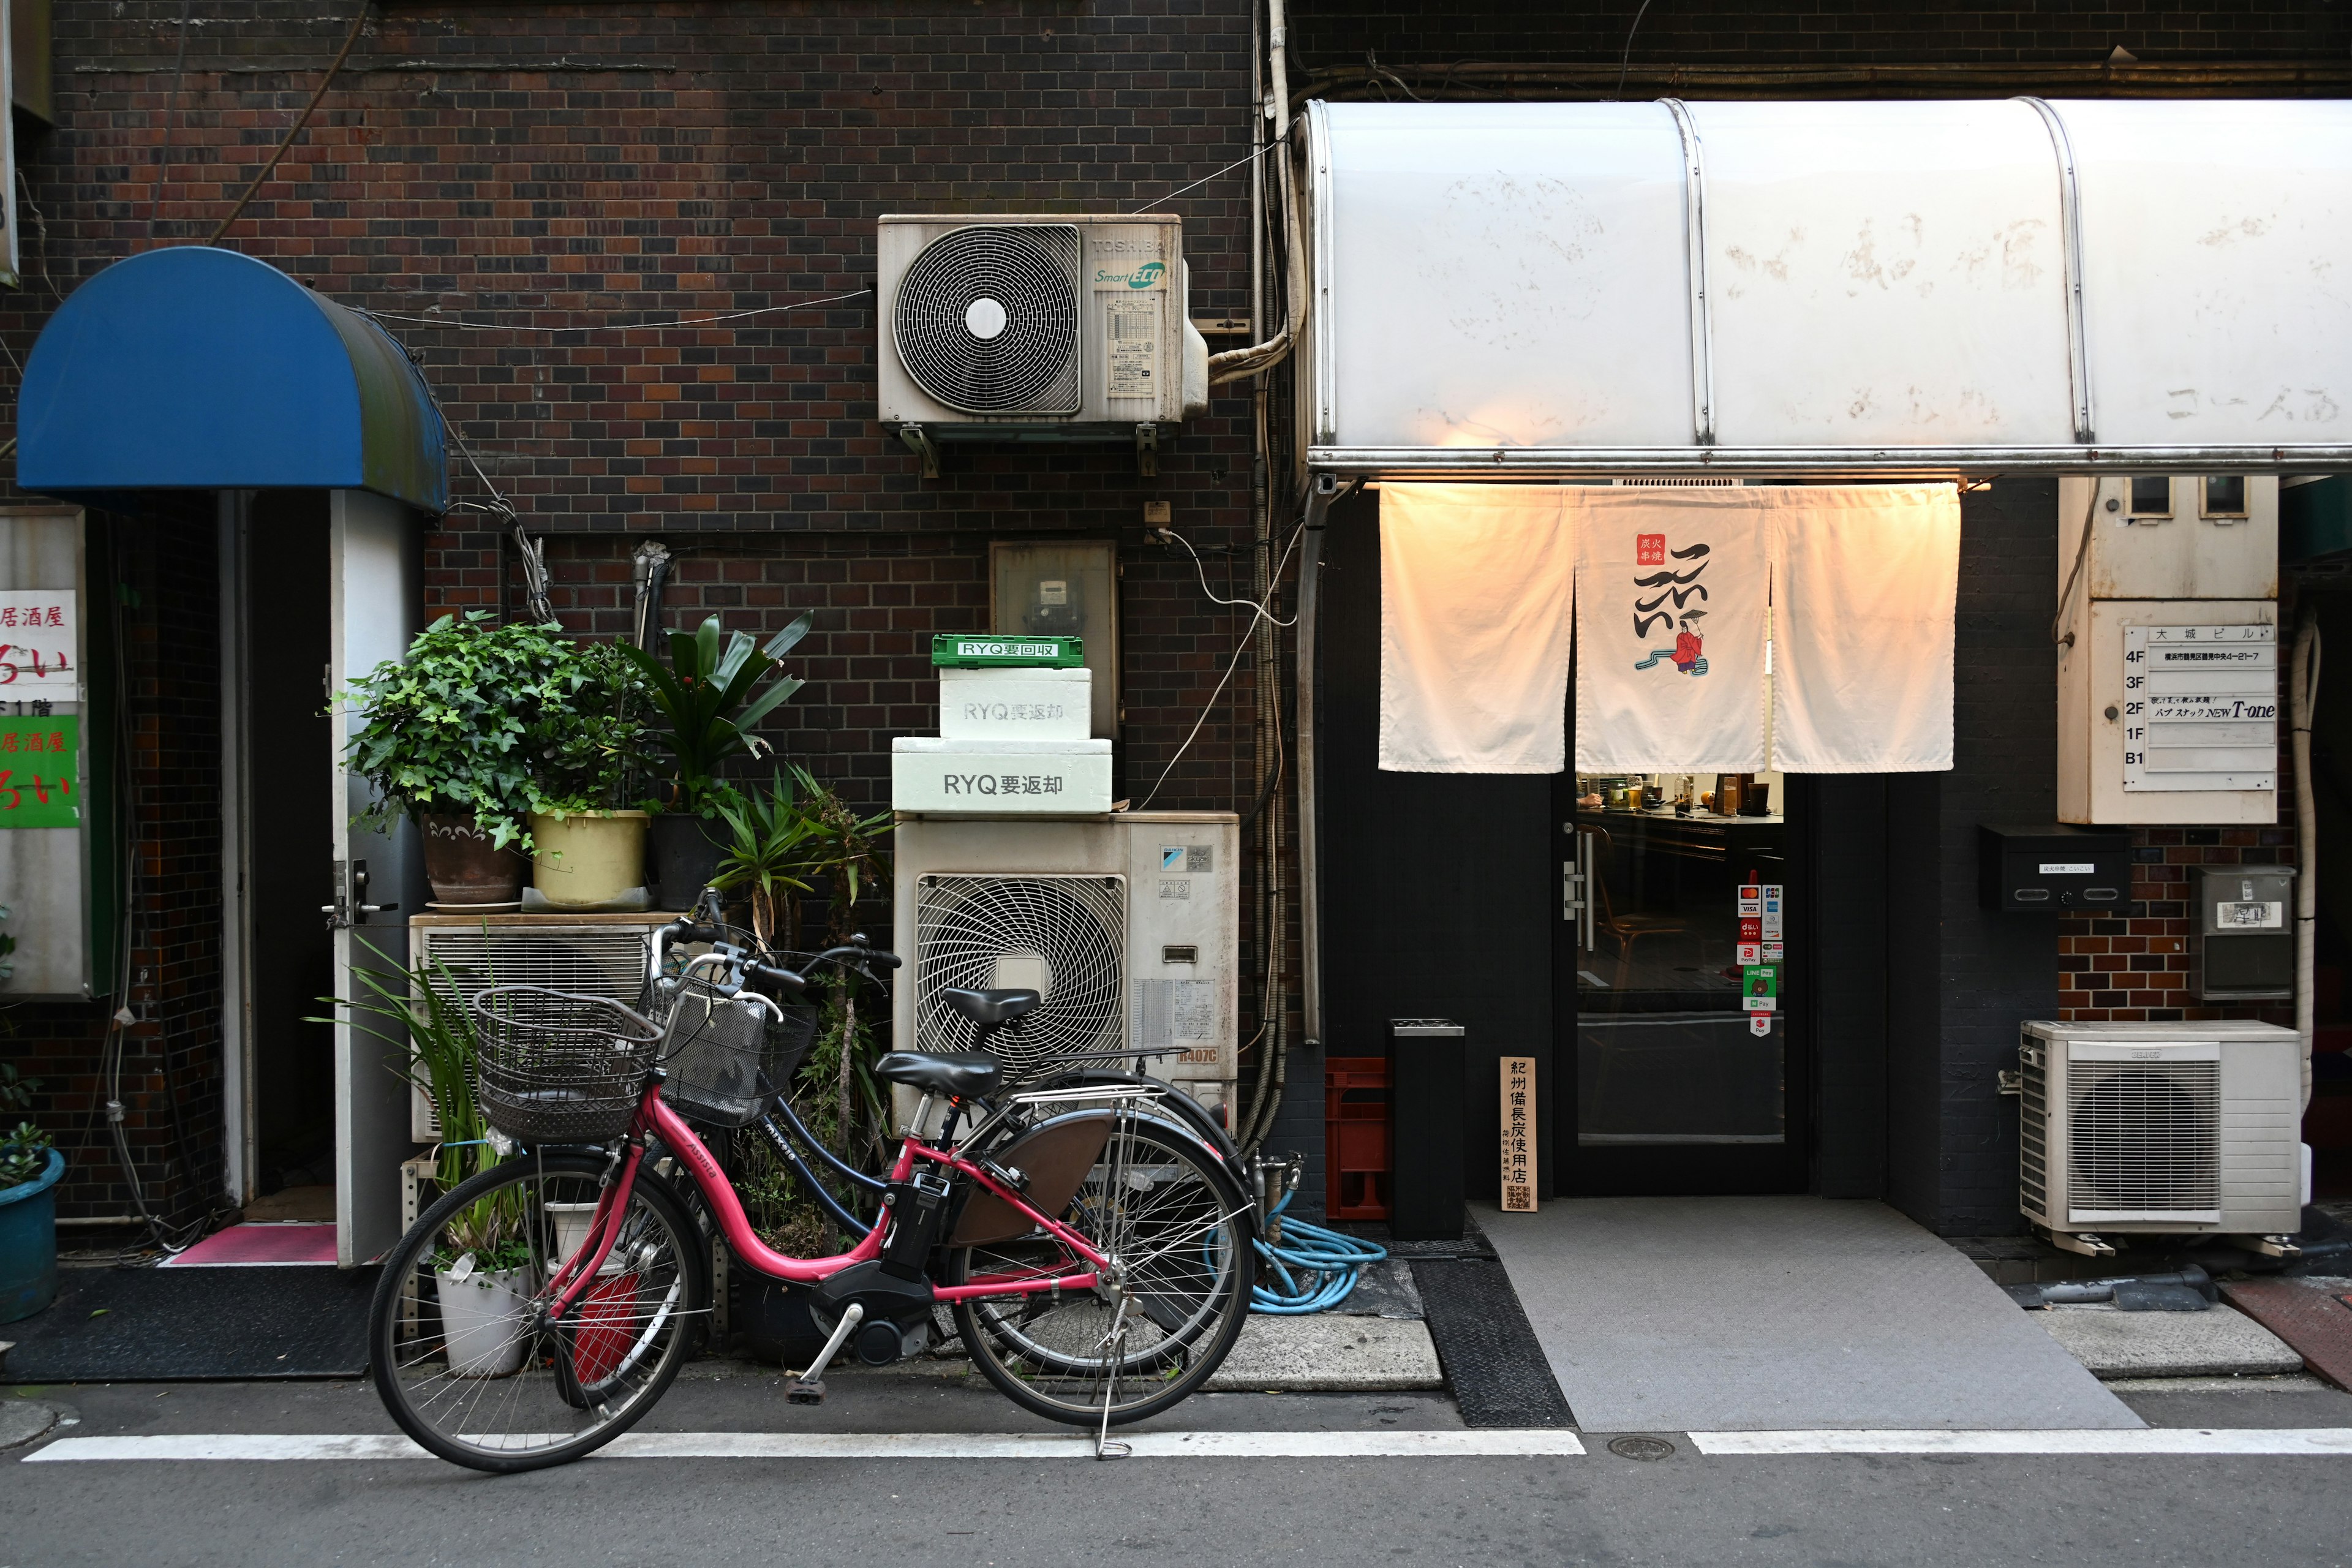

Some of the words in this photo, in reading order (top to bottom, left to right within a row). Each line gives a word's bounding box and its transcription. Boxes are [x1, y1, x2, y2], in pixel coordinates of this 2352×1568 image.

[1092, 239, 1166, 252] TOSHIBA
[1095, 270, 1129, 282] Smart
[1640, 538, 1662, 549] 炭火
[1641, 551, 1662, 561] 串焼
[0, 606, 65, 628] 居酒屋
[2156, 628, 2254, 639] 大城ビル
[963, 644, 1054, 656] RYQ要回収
[2125, 651, 2144, 663] 4F
[2125, 676, 2144, 688] 3F
[0, 698, 53, 718] 1階
[964, 703, 1064, 721] RYQ要返却
[2125, 703, 2144, 715] 2F
[2155, 708, 2173, 717] パブ
[2175, 709, 2204, 717] スナック
[2205, 709, 2231, 718] NEW
[2232, 701, 2275, 718] T-one
[2126, 728, 2144, 740] 1F
[1, 731, 67, 753] 居酒屋
[2125, 752, 2144, 764] B1
[944, 774, 1063, 796] RYQ要返却
[1180, 1049, 1216, 1062] R407C
[1510, 1061, 1527, 1183] 紀州備長炭使用店
